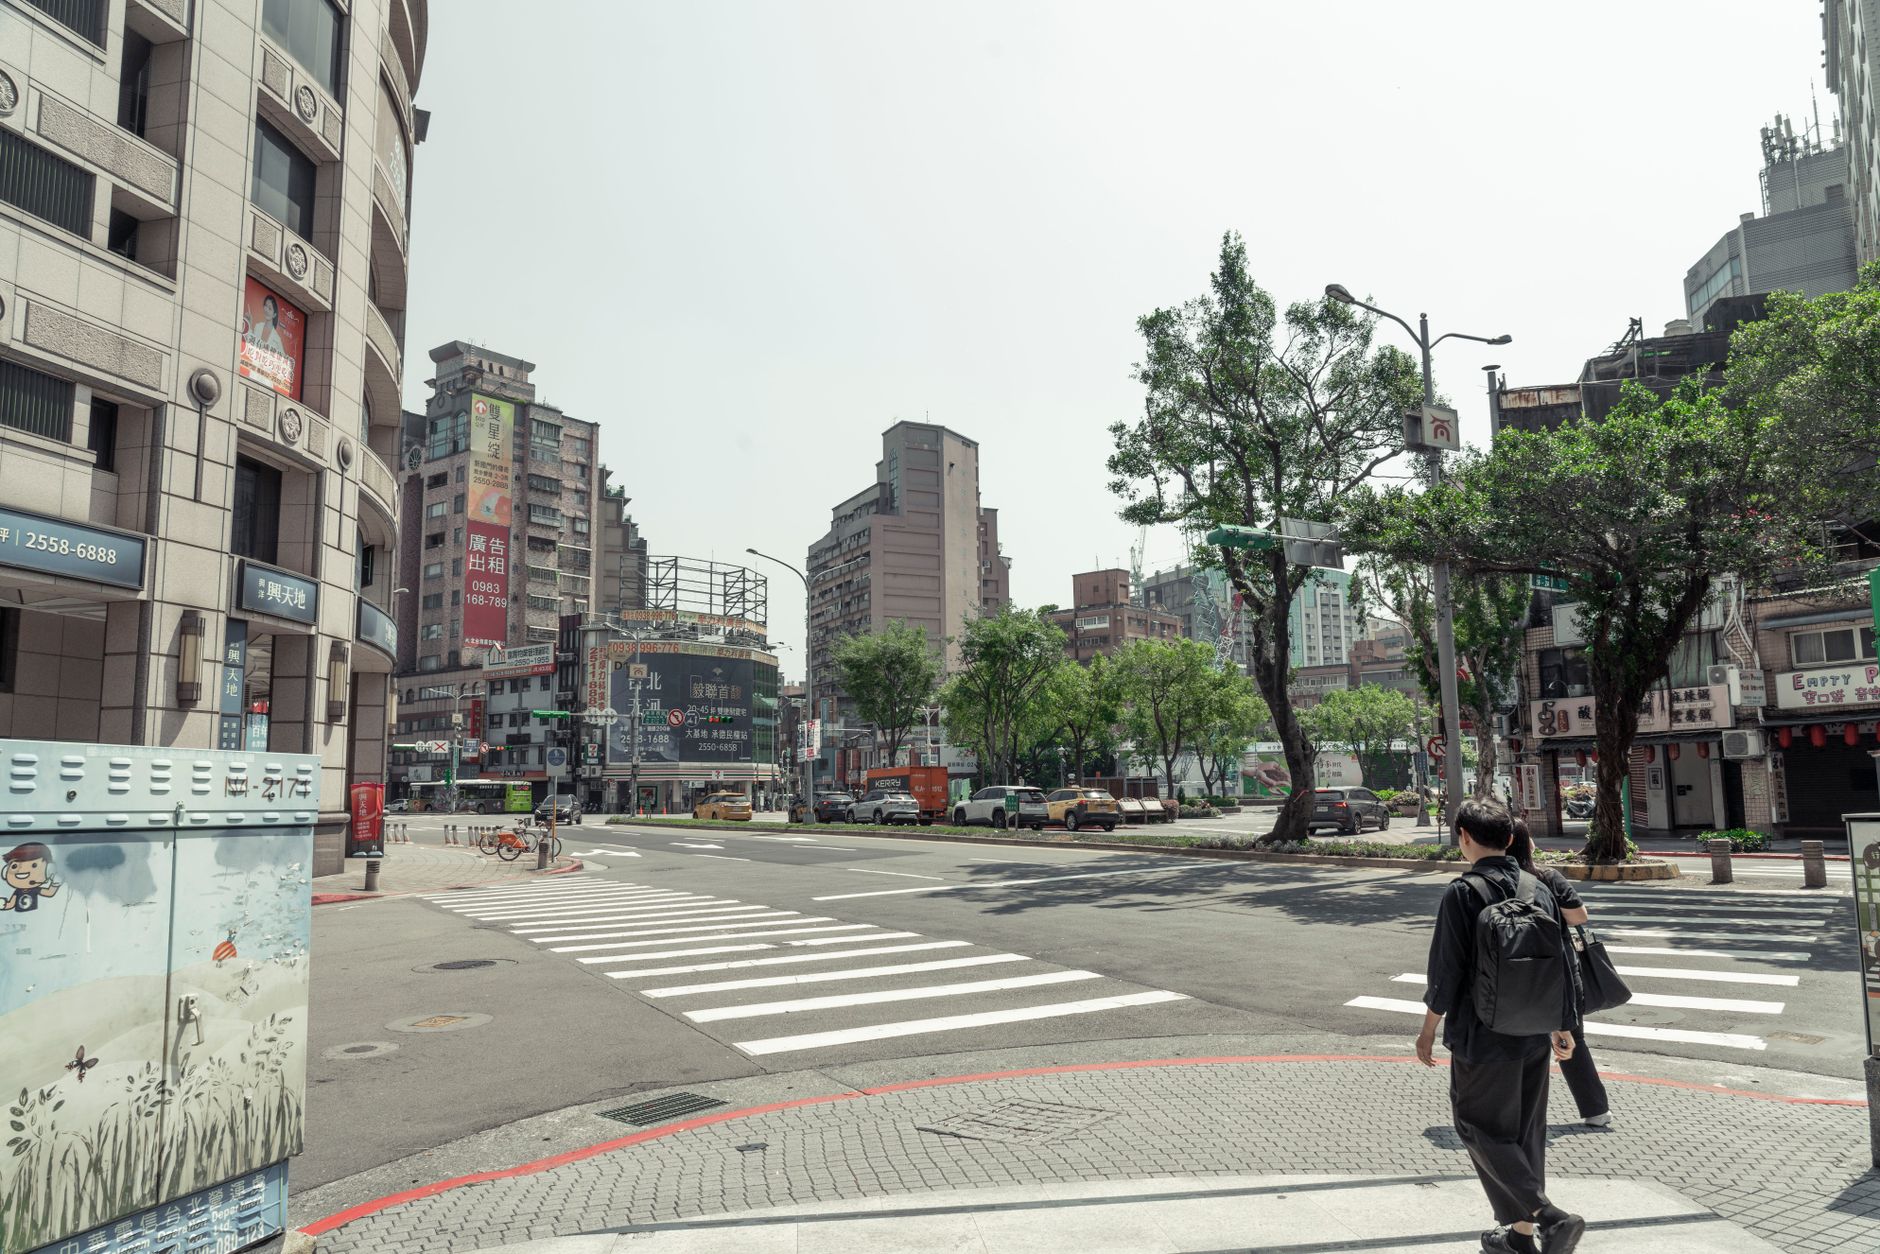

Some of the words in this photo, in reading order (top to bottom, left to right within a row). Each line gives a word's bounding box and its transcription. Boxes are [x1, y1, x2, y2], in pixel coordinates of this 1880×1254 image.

[25, 531, 117, 564] 2558-6888
[469, 533, 506, 556] 廣告
[469, 554, 505, 575] 出租
[267, 581, 306, 610] 興天地
[472, 580, 500, 593] 0983
[466, 593, 507, 608] 168-789
[226, 648, 240, 697] 興天地
[875, 779, 901, 788] KERRY
